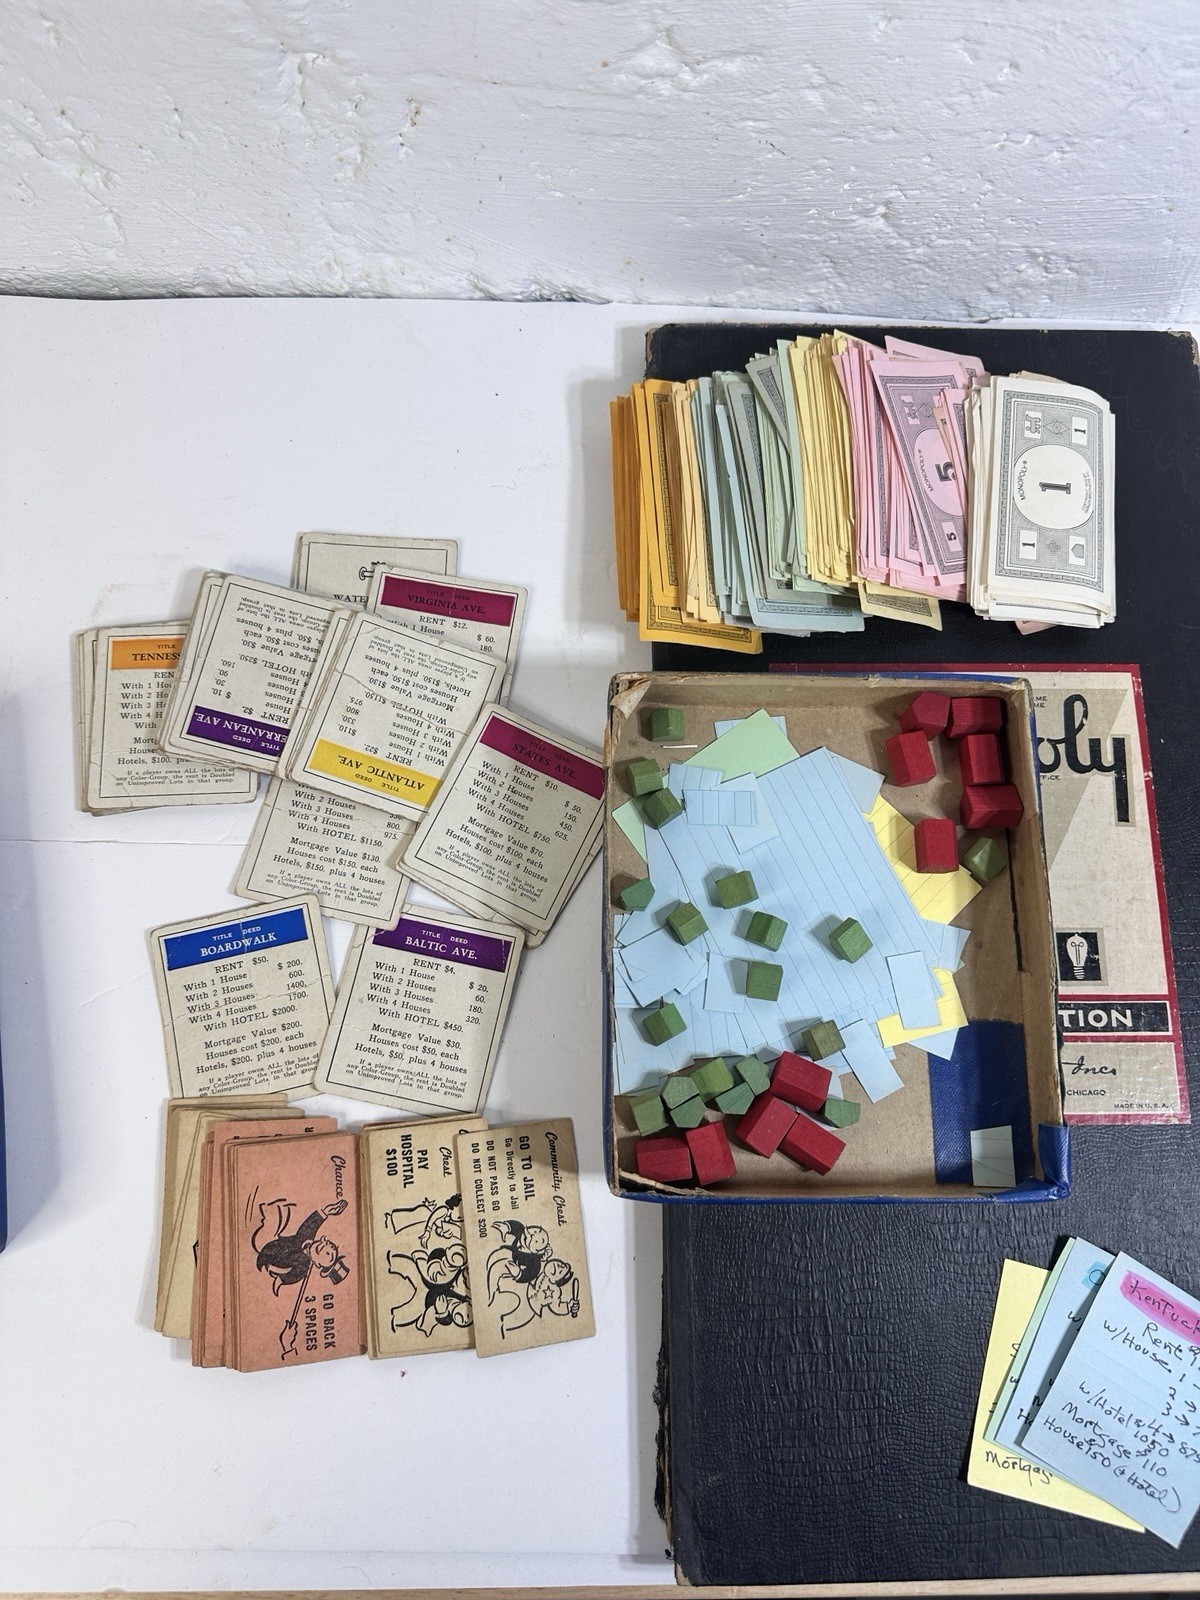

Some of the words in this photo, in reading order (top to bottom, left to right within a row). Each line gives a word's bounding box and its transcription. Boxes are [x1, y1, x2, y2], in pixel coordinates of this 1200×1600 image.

[934, 461, 957, 483] 5
[1038, 481, 1072, 495] 1
[946, 531, 957, 542] 5
[407, 594, 458, 610] VIRGINIA
[461, 604, 486, 615] AVE.
[419, 615, 446, 626] RENT
[453, 620, 468, 630] $12.
[194, 712, 221, 726] AVE.
[242, 705, 254, 715] $2.
[260, 711, 290, 725] RENT
[222, 720, 288, 743] ERRANEAN
[232, 734, 251, 744] DEED
[260, 741, 280, 751] TITLE
[364, 743, 379, 755] $22.
[338, 755, 363, 769] AVE.
[385, 752, 413, 766] RENT
[512, 743, 551, 767] STATES
[553, 764, 577, 780] AVE.
[1037, 694, 1129, 822] oly
[354, 773, 373, 783] DEED
[366, 765, 425, 790] ATLANTIC
[381, 782, 399, 793] TITLE
[513, 765, 540, 781] RENT
[544, 780, 559, 792] $10.
[476, 802, 496, 818] With
[498, 814, 530, 835] HOTEL
[532, 831, 551, 845] $750.
[297, 822, 319, 833] With
[322, 827, 357, 842] HOTEL
[360, 836, 384, 848] $1150.
[467, 816, 504, 839] Mortgage
[507, 834, 528, 851] Value
[529, 846, 544, 859] $70.
[290, 836, 330, 853] Mortgage
[335, 846, 358, 858] Value
[361, 852, 381, 863] $130.
[212, 932, 233, 941] TITLE
[242, 926, 262, 936] DEED
[422, 930, 441, 939] TITLE
[450, 936, 468, 945] DEED
[200, 932, 277, 957] BOARDWALK
[405, 936, 448, 953] BALTIC
[451, 947, 477, 960] AVE.
[183, 981, 208, 992] With
[219, 973, 248, 984] House
[286, 958, 303, 969] 200.
[214, 960, 244, 974] RENT
[252, 955, 269, 966] $50.
[412, 958, 442, 971] RENT
[444, 965, 456, 975] $4.
[185, 991, 209, 1003] With
[212, 989, 218, 997] 2
[222, 982, 254, 995] Houses
[288, 969, 305, 979] 600.
[375, 961, 397, 973] With
[401, 967, 405, 975] 1
[409, 968, 436, 981] House
[477, 983, 489, 993] 20.
[203, 1021, 227, 1032] With
[231, 1011, 269, 1026] HOTEL
[272, 1004, 298, 1017] $2000.
[379, 1007, 401, 1019] With
[404, 1012, 440, 1028] HOTEL
[443, 1021, 464, 1033] $450.
[1058, 1009, 1133, 1028] TION
[204, 1035, 247, 1050] Mortgage
[251, 1027, 277, 1038] Value
[281, 1020, 303, 1032] $200.
[205, 1048, 238, 1061] Houses
[240, 1042, 259, 1052] cost
[260, 1036, 283, 1048] $200.
[284, 1030, 305, 1042] each
[371, 1023, 412, 1040] Mortgage
[418, 1033, 442, 1046] Value
[445, 1039, 462, 1050] $30.
[196, 1061, 228, 1075] Hotels,
[230, 1055, 253, 1067] $200.
[256, 1050, 276, 1062] plus
[288, 1040, 318, 1053] houses
[368, 1034, 400, 1048] Houses
[402, 1043, 419, 1052] cost
[421, 1045, 438, 1056] $50.
[440, 1051, 460, 1061] each
[354, 1042, 385, 1057] Hotels,
[388, 1049, 405, 1061] $50.
[408, 1055, 427, 1066] plus
[430, 1059, 436, 1067] 4
[439, 1061, 468, 1075] houses
[471, 1142, 480, 1154] DO
[486, 1140, 495, 1151] DO
[504, 1137, 513, 1148] Go
[519, 1136, 530, 1150] GO
[385, 1148, 398, 1177] $100
[400, 1134, 414, 1189] HOSPITAL
[417, 1149, 429, 1170] PAY
[438, 1146, 453, 1178] Chest
[472, 1158, 482, 1174] NOT
[487, 1155, 497, 1172] NOT
[506, 1150, 516, 1180] Directly
[521, 1155, 533, 1171] TO
[545, 1131, 563, 1192] Community
[330, 1155, 346, 1200] Chance
[489, 1175, 499, 1196] PASS
[509, 1183, 517, 1192] to
[474, 1178, 486, 1214] COLLECT
[522, 1176, 535, 1201] JAIL
[491, 1200, 501, 1212] GO
[510, 1195, 520, 1210] Jail
[552, 1195, 567, 1227] Chest
[477, 1218, 488, 1238] $200
[304, 1295, 317, 1303] 3
[322, 1293, 334, 1310] GO
[304, 1307, 318, 1352] SPACES
[323, 1317, 336, 1350] BACK
